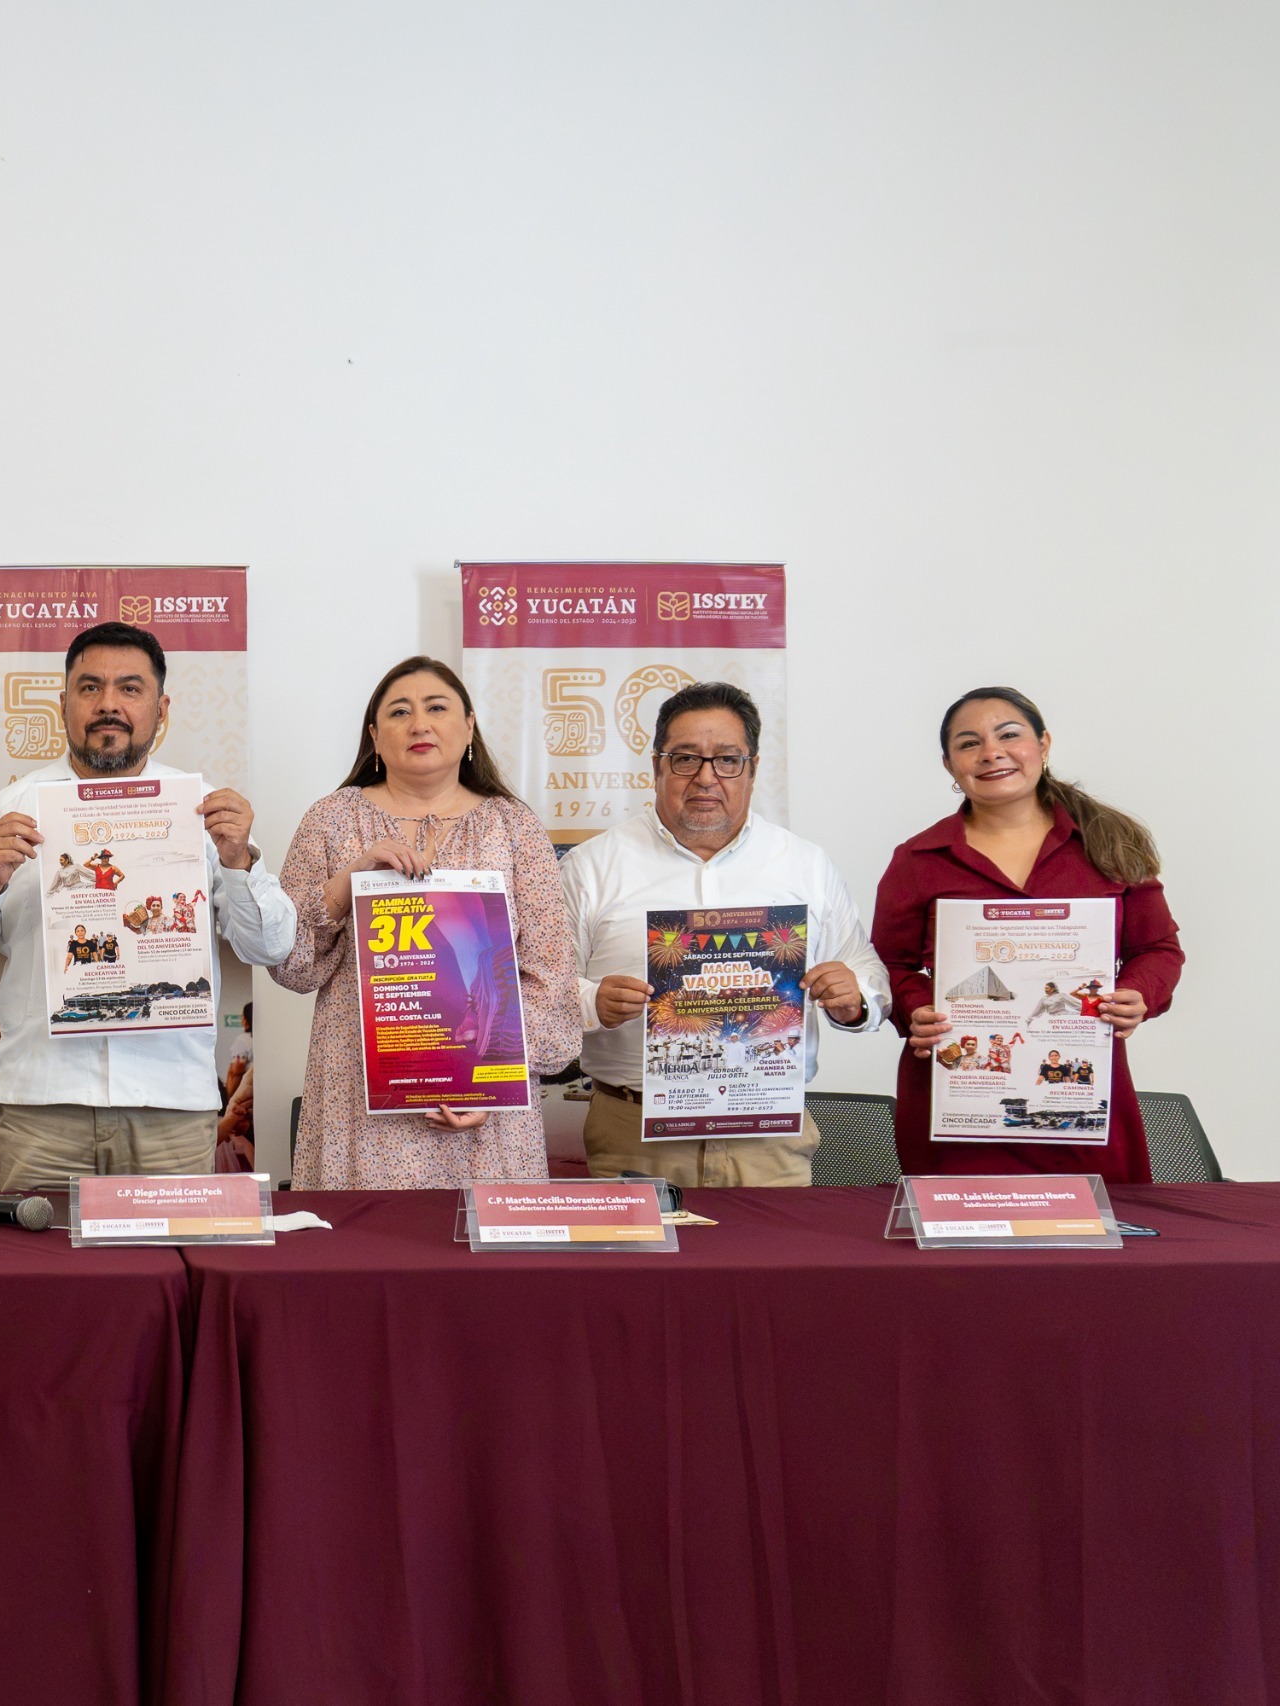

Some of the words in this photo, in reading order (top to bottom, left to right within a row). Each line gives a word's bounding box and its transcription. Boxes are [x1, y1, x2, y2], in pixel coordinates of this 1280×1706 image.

[154, 597, 228, 612] ISSTEY
[527, 596, 636, 614] YUCATÁN
[693, 593, 767, 609] ISSTEY
[545, 772, 656, 790] ANIVERS
[554, 801, 611, 817] 1976
[114, 820, 169, 829] ANIVERSARIO
[372, 898, 424, 908] CAMINATA
[372, 905, 434, 915] RECREATIVA
[368, 914, 435, 952] 3K
[703, 964, 751, 974] MAGNA
[684, 969, 771, 992] VAQUERÍA
[375, 1002, 397, 1012] 7:30
[399, 1001, 422, 1011] A.M.
[117, 1189, 133, 1197] C.P.
[135, 1188, 157, 1197] Diego
[159, 1188, 182, 1196] David
[184, 1188, 201, 1196] Cetz
[933, 1193, 963, 1201] MTRO.
[965, 1193, 982, 1201] Luis
[983, 1192, 1010, 1201] Héctor
[1012, 1192, 1044, 1201] Barrera
[1046, 1192, 1075, 1200] Huerta
[488, 1197, 504, 1205] C.P.
[506, 1197, 533, 1205] Martha
[606, 1196, 645, 1204] Caballero
